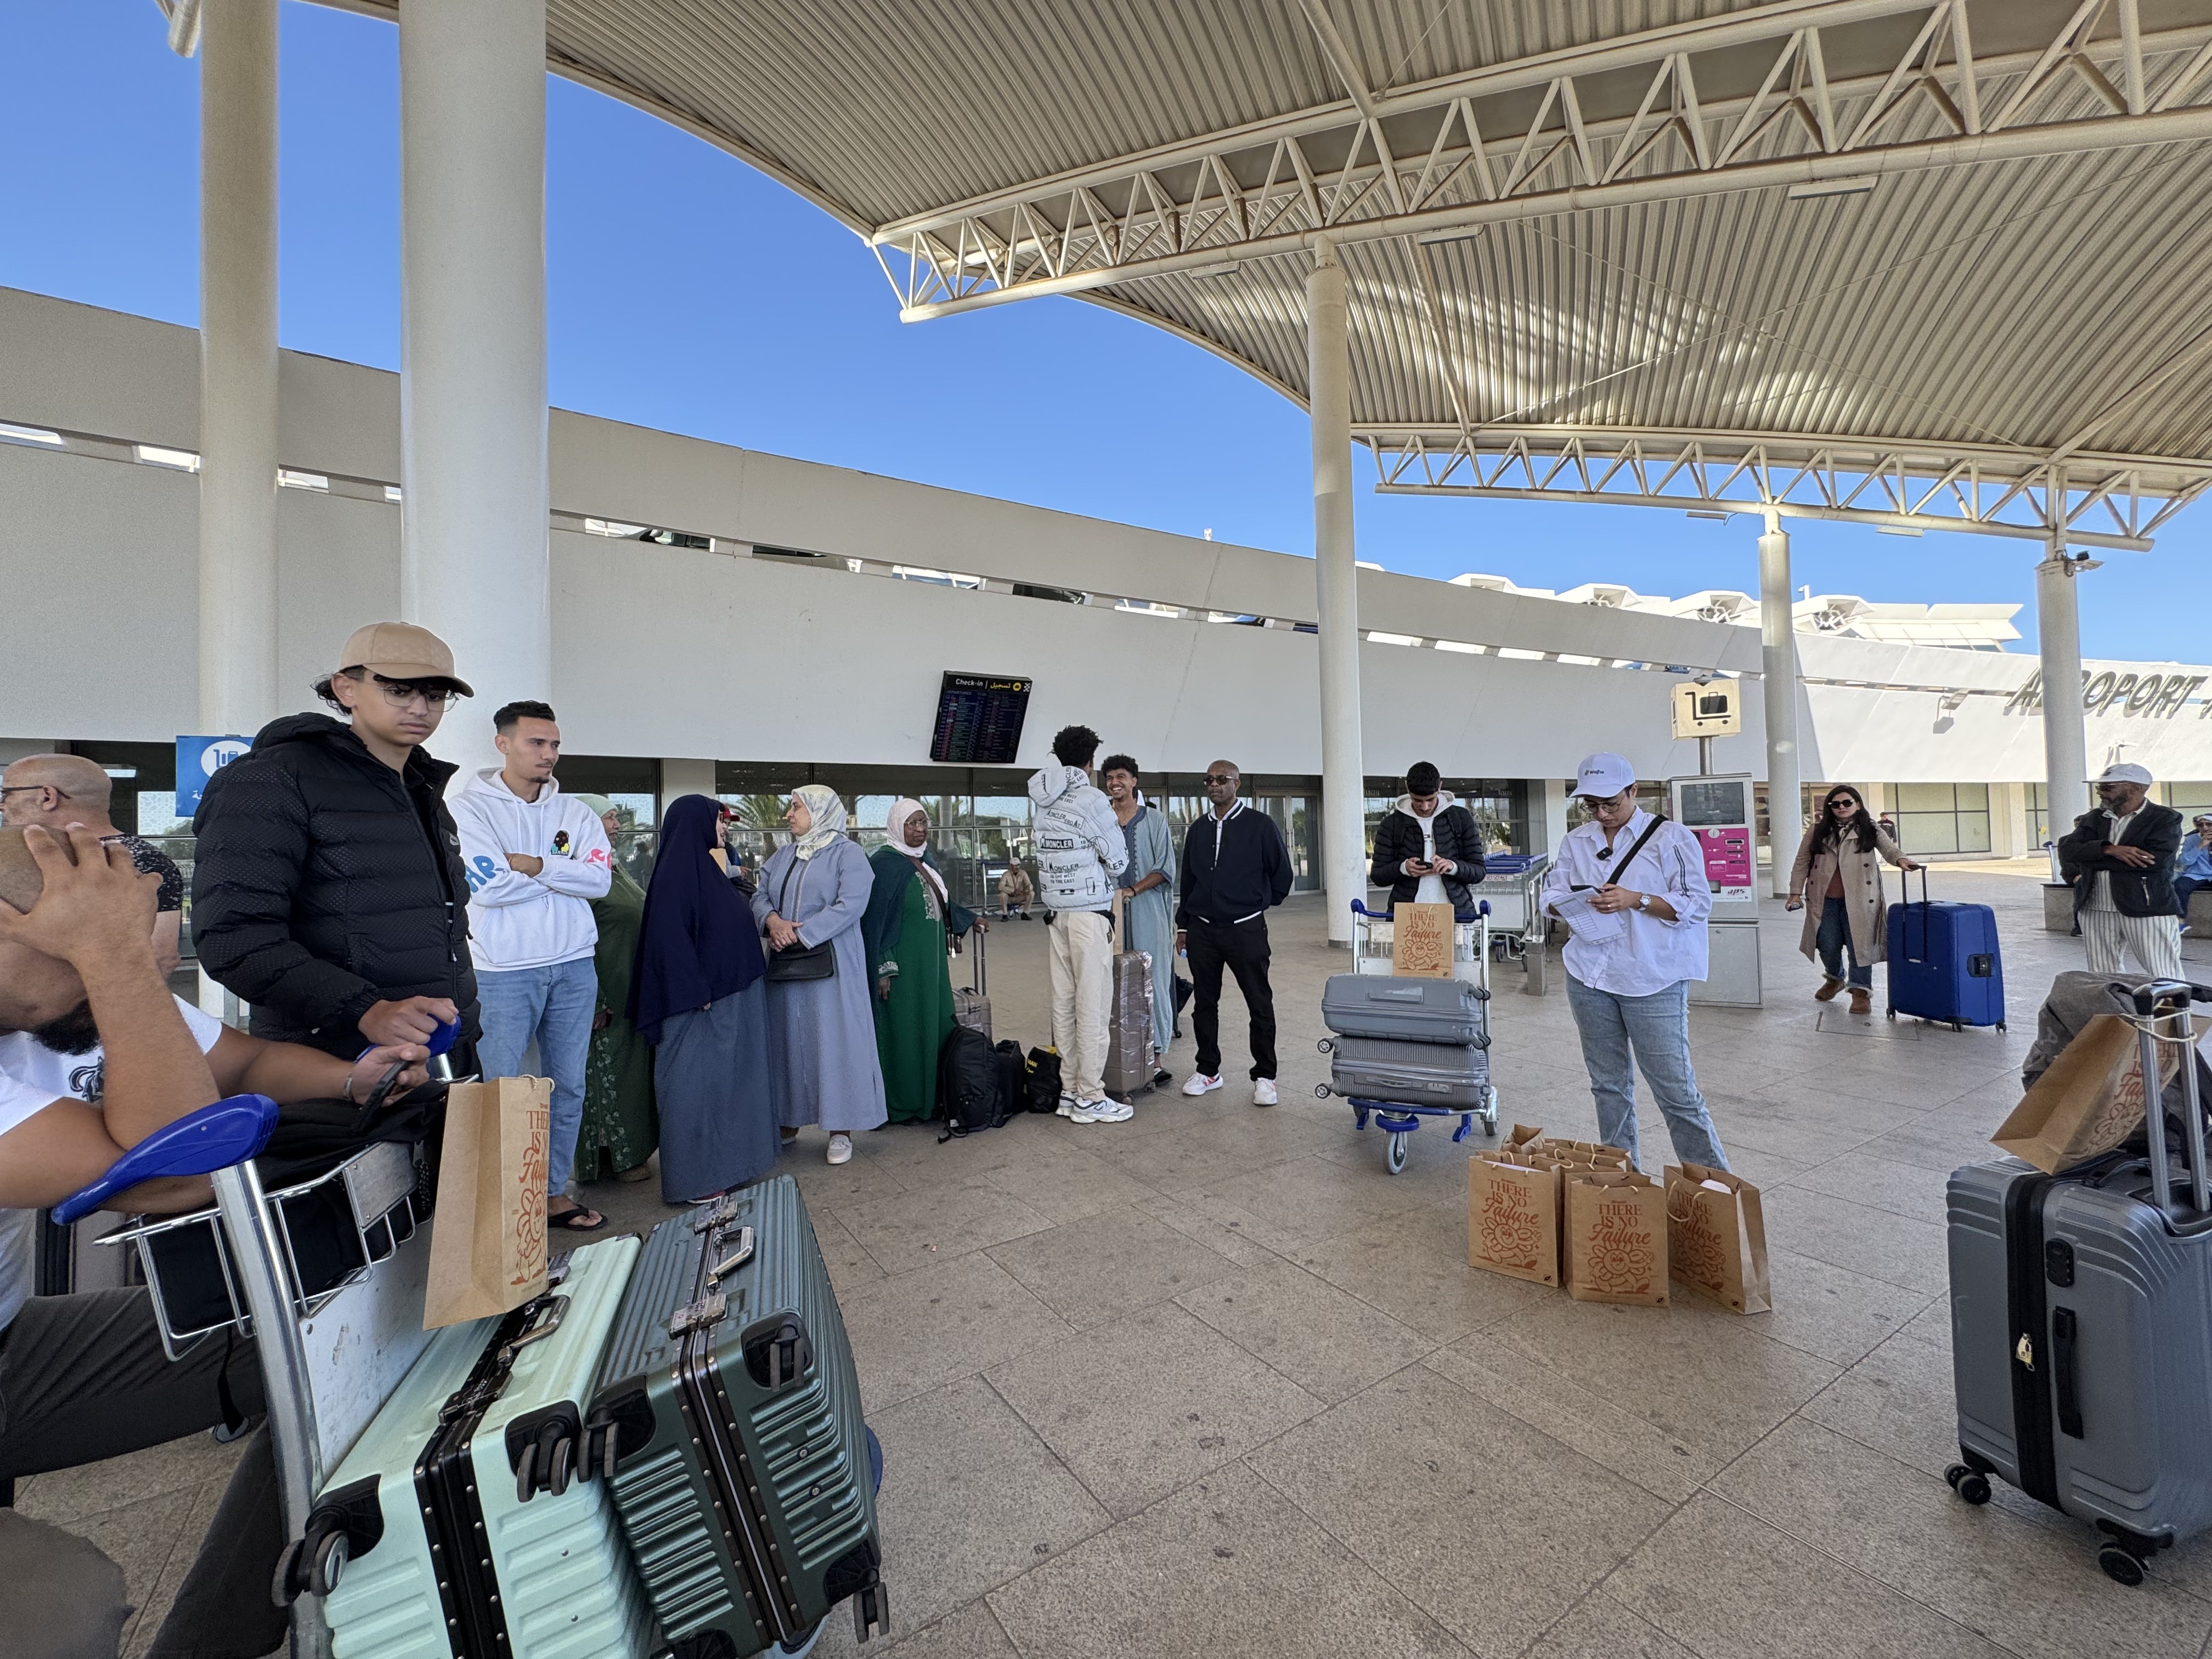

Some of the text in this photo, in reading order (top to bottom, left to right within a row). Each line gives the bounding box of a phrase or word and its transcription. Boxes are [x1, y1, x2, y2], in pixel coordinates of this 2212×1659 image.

[955, 678, 983, 687] Check-in
[2004, 666, 2209, 715] AOPORT
[1045, 839, 1073, 849] MONCLER
[1049, 861, 1079, 872] MONCLER
[1408, 913, 1437, 921] THERE
[1412, 921, 1419, 929] IS
[531, 1132, 541, 1151] IS
[1488, 1179, 1532, 1198] THERE
[1492, 1190, 1527, 1207] IS NO
[1481, 1197, 1539, 1225] Failure
[1595, 1204, 1643, 1216] THERE
[1601, 1215, 1638, 1227] IS NO
[1588, 1223, 1651, 1245] Failure
